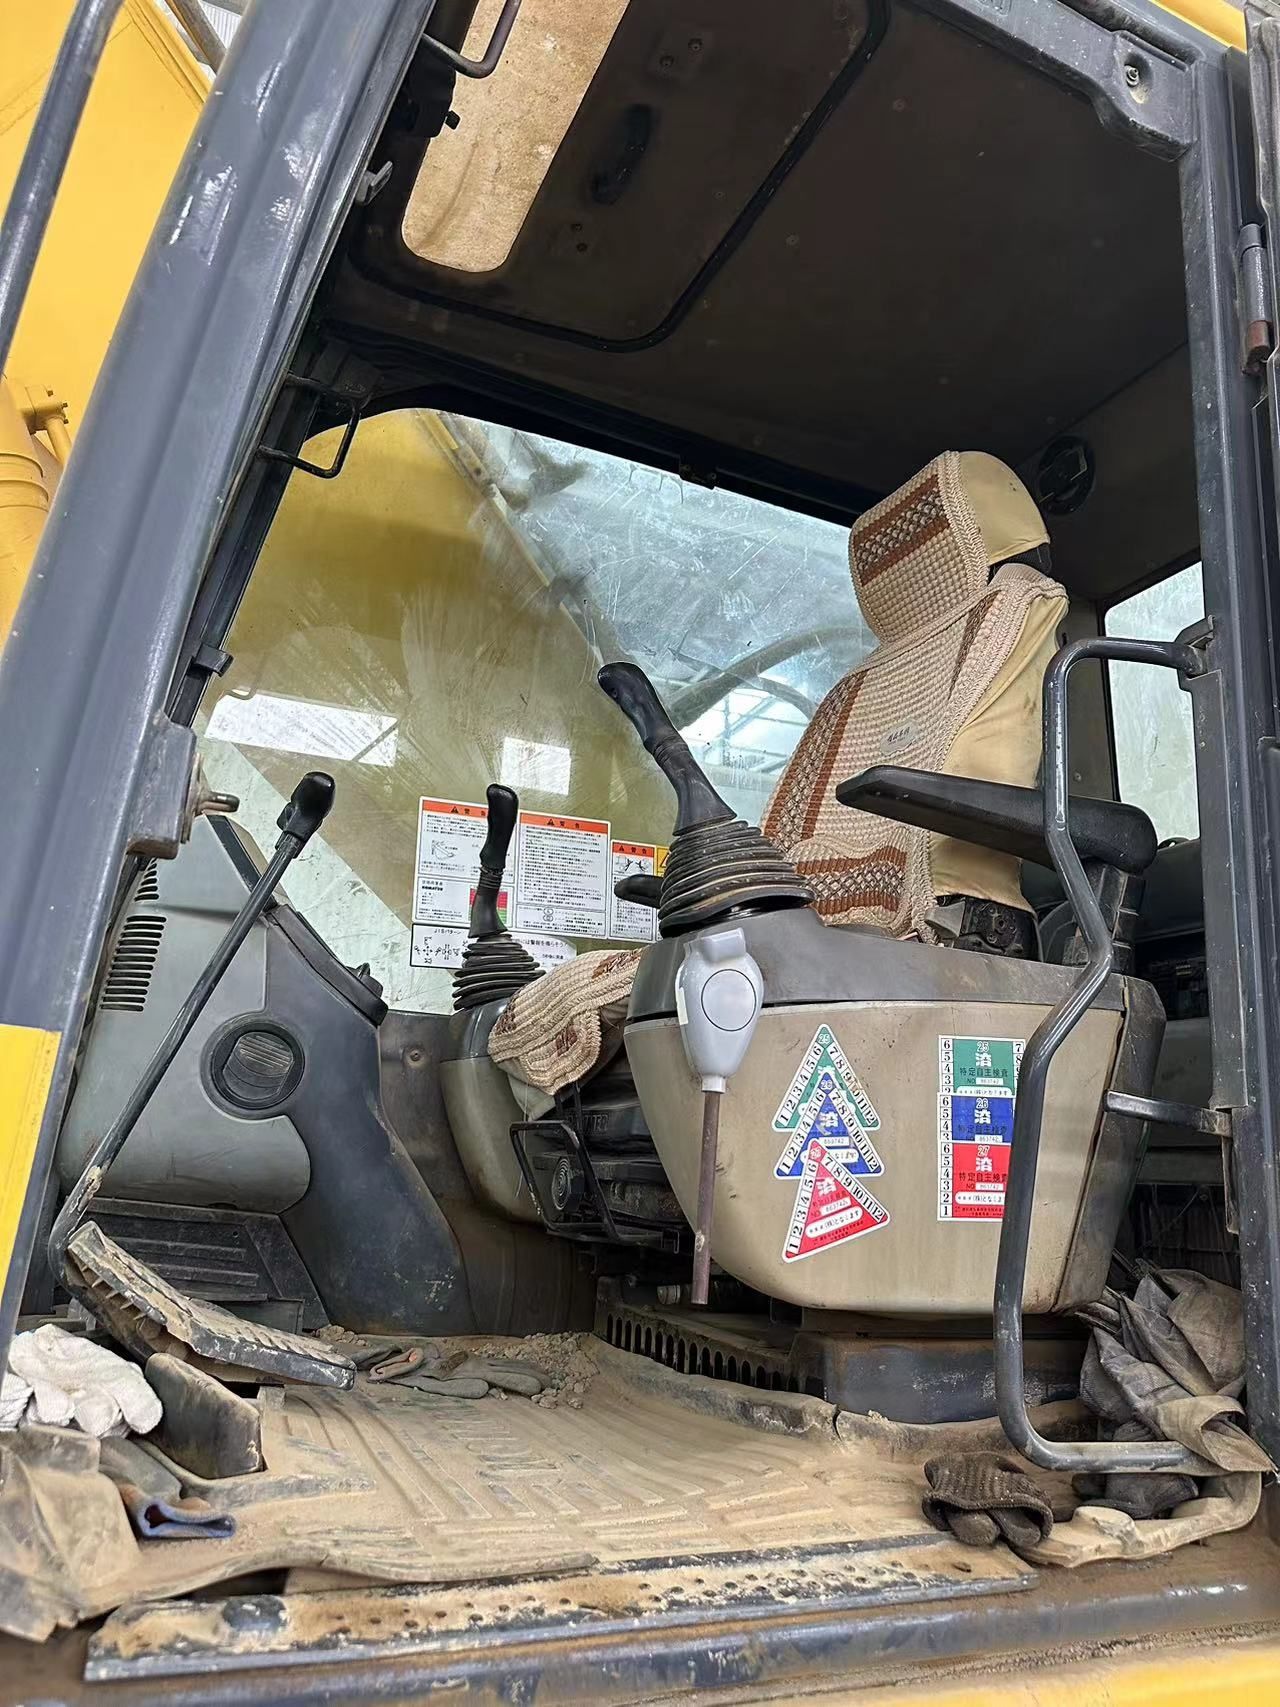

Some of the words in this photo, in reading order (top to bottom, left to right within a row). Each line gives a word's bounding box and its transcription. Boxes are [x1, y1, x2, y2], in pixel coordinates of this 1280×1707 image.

[944, 1040, 950, 1049] 6
[976, 1041, 990, 1052] 25
[1015, 1043, 1022, 1052] 7
[944, 1052, 950, 1061] 5
[944, 1064, 950, 1073] 4
[960, 1067, 1008, 1077] 特定自主検査
[780, 1114, 789, 1122] 1
[786, 1099, 796, 1110] 2
[793, 1086, 802, 1096] 3
[800, 1073, 808, 1082] 4
[806, 1059, 816, 1070] 5
[813, 1045, 822, 1056] 6
[944, 1074, 951, 1085] 3
[830, 1046, 838, 1054] 7
[836, 1060, 845, 1069] 8
[843, 1072, 852, 1081] 9
[857, 1098, 868, 1110] 11
[866, 1110, 877, 1124] 12
[942, 1096, 949, 1105] 6
[975, 1098, 989, 1109] 26
[942, 1108, 949, 1118] 5
[942, 1121, 949, 1130] 4
[782, 1161, 790, 1170] 1
[788, 1146, 798, 1158] 2
[796, 1133, 805, 1144] 3
[802, 1120, 811, 1129] 4
[808, 1106, 818, 1116] 5
[815, 1092, 824, 1102] 6
[832, 1092, 841, 1102] 7
[838, 1105, 848, 1115] 8
[846, 1118, 854, 1128] 9
[852, 1130, 863, 1143] 10
[860, 1144, 870, 1156] 11
[866, 1156, 878, 1170] 12
[944, 1143, 950, 1153] 6
[977, 1144, 990, 1157] 27
[943, 1156, 950, 1166] 5
[808, 1163, 817, 1172] 6
[943, 1168, 950, 1178] 4
[804, 1178, 814, 1188] 5
[824, 1156, 834, 1166] 7
[833, 1167, 842, 1178] 8
[843, 1177, 853, 1188] 9
[852, 1186, 863, 1200] 10
[862, 1196, 874, 1210] 11
[872, 1207, 884, 1220] 12
[943, 1180, 950, 1190] 3
[800, 1196, 810, 1205] 4
[943, 1193, 950, 1202] 2
[796, 1210, 806, 1220] 3
[944, 1205, 948, 1215] 1
[793, 1226, 803, 1236] 2
